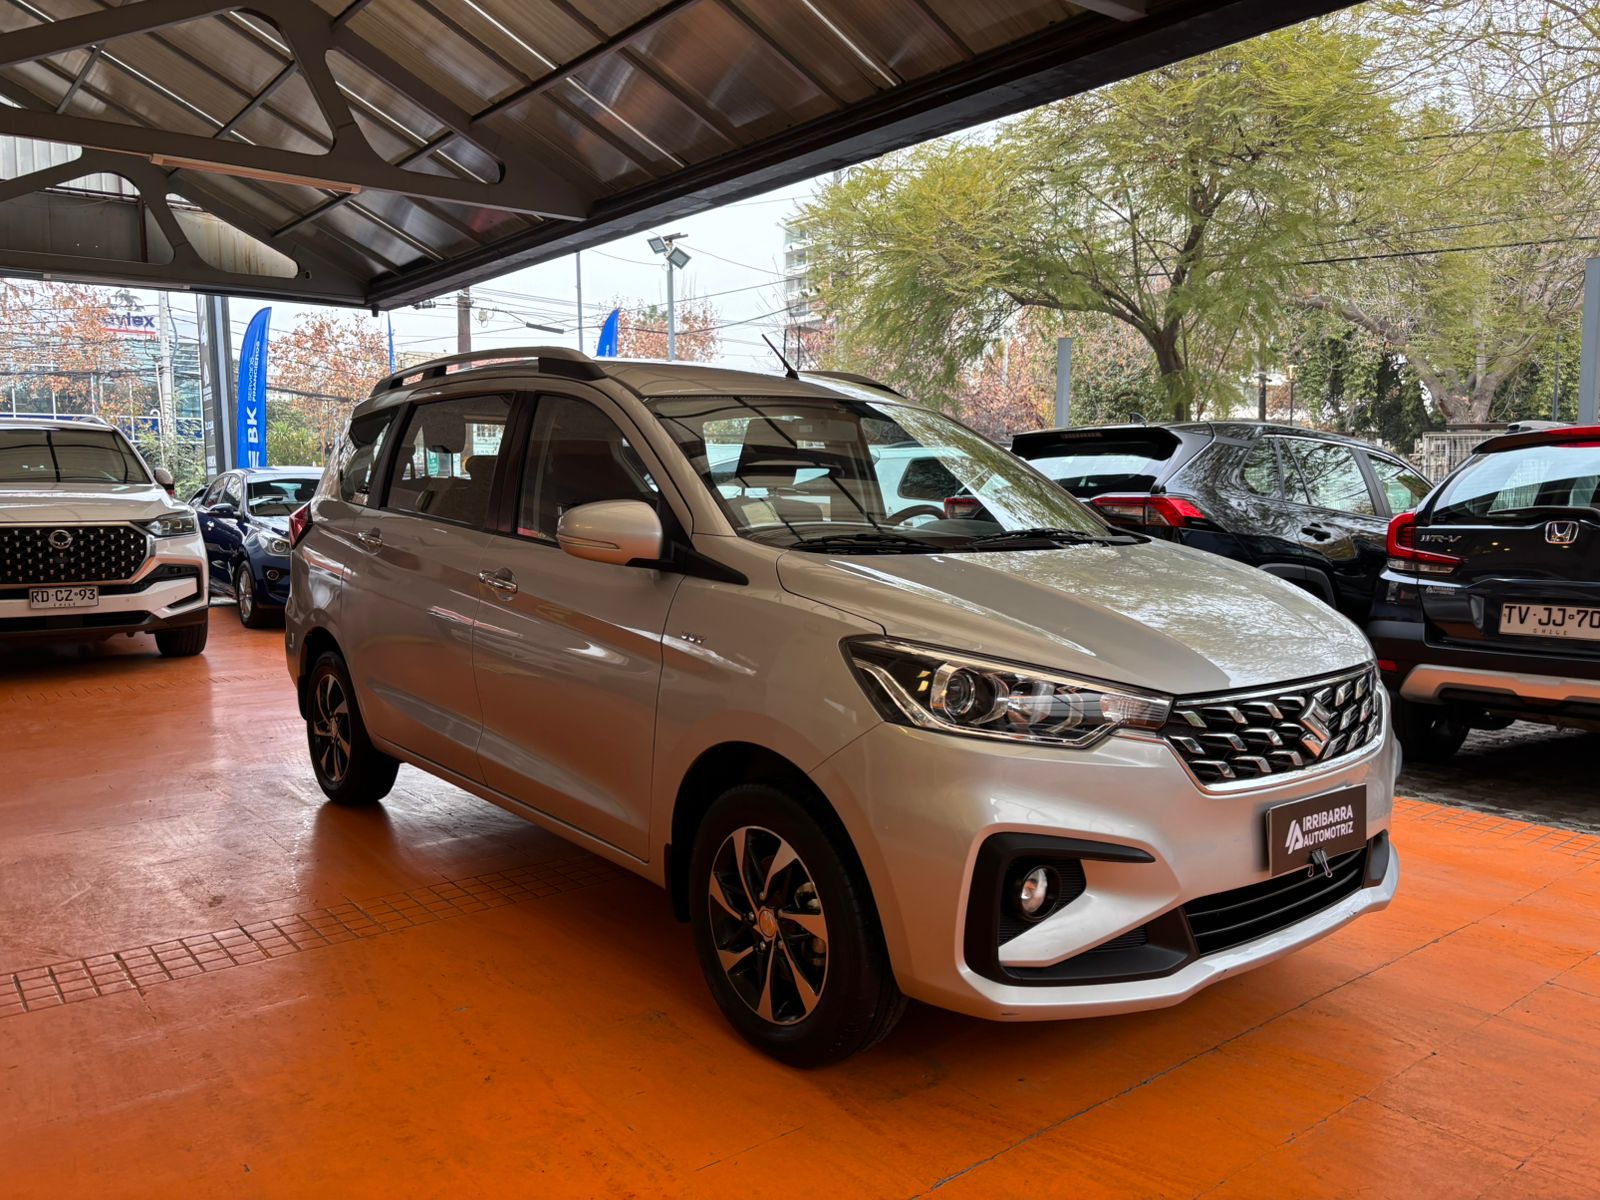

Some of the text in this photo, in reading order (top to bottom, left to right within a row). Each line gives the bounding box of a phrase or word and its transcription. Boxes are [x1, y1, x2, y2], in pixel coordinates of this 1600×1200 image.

[252, 341, 260, 402] FINANCIEROS
[246, 406, 259, 443] BK
[1420, 534, 1462, 543] WR-V
[1302, 804, 1354, 831] IRRIBARRA
[1303, 821, 1354, 847] AUTOMOTRIZ
